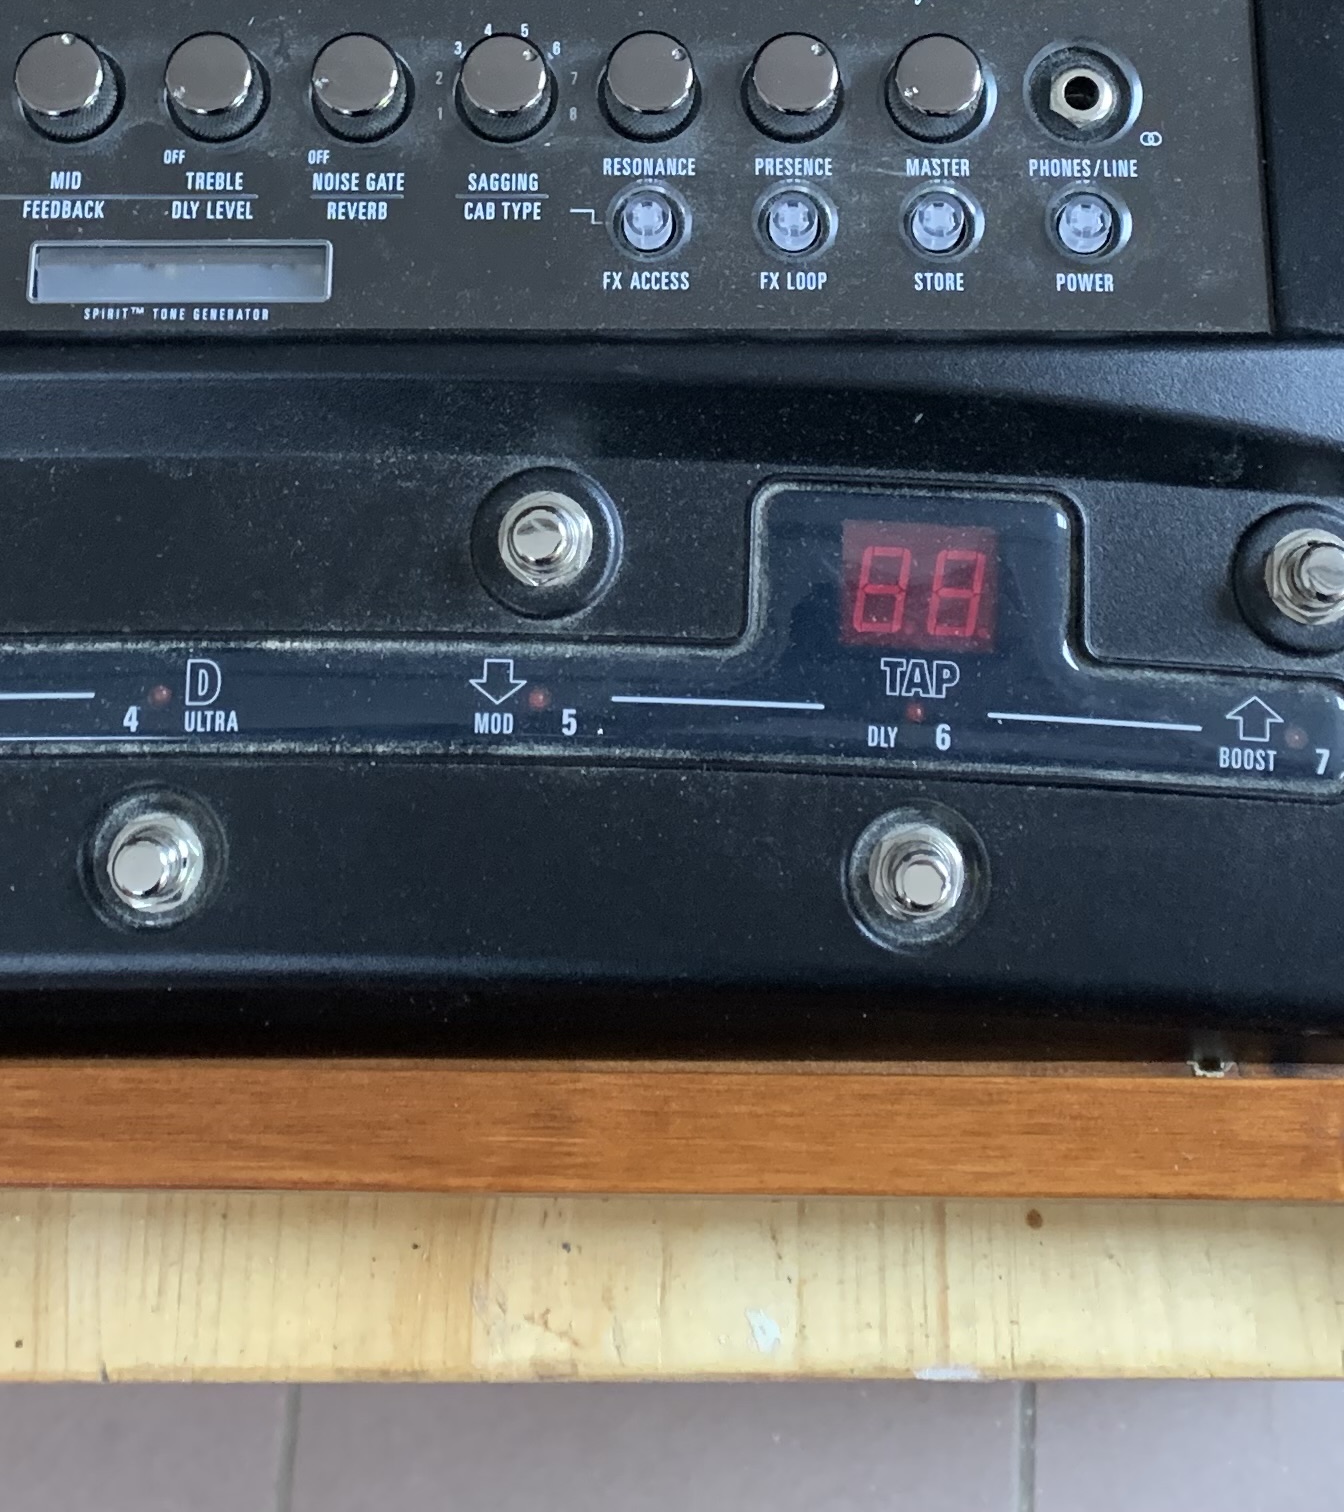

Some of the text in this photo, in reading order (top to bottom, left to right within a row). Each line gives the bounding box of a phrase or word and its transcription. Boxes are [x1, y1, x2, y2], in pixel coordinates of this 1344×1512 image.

[483, 23, 493, 37] 4
[520, 23, 530, 38] 5
[453, 41, 463, 56] 3
[552, 41, 562, 56] 6
[434, 71, 444, 86] 2
[570, 71, 579, 87] 7
[568, 107, 578, 122] 8
[162, 149, 187, 165] OFF
[307, 149, 331, 166] OFF
[602, 157, 697, 177] RESONANCE
[754, 157, 833, 177] PRESENCE
[905, 157, 971, 178] MASTER
[1028, 158, 1139, 179] PHONES/LINE
[49, 170, 83, 191] MID
[184, 170, 245, 192] TREBLE
[311, 172, 406, 192] NOISE GATE
[467, 172, 540, 192] SAGGING
[21, 199, 106, 220] FEEDBACK
[170, 199, 255, 221] DLY LEVEL
[326, 201, 389, 221] REVERB
[463, 201, 543, 221] CAB TYPE
[602, 271, 690, 291] FX ACCESS
[759, 271, 828, 291] FX LOOP
[913, 271, 965, 293] STORE
[1055, 272, 1115, 293] POWER
[151, 307, 186, 322] TONE
[192, 307, 270, 322] GENERATOR
[184, 658, 222, 707] D
[880, 657, 961, 699] TAP
[122, 705, 139, 733] 4
[183, 709, 240, 734] ULTRA
[472, 712, 514, 736] MOD
[560, 708, 578, 737] 5
[866, 724, 899, 749] DLY
[934, 723, 952, 751] 6
[1218, 746, 1277, 772] BOOST
[1314, 747, 1331, 776] 7
